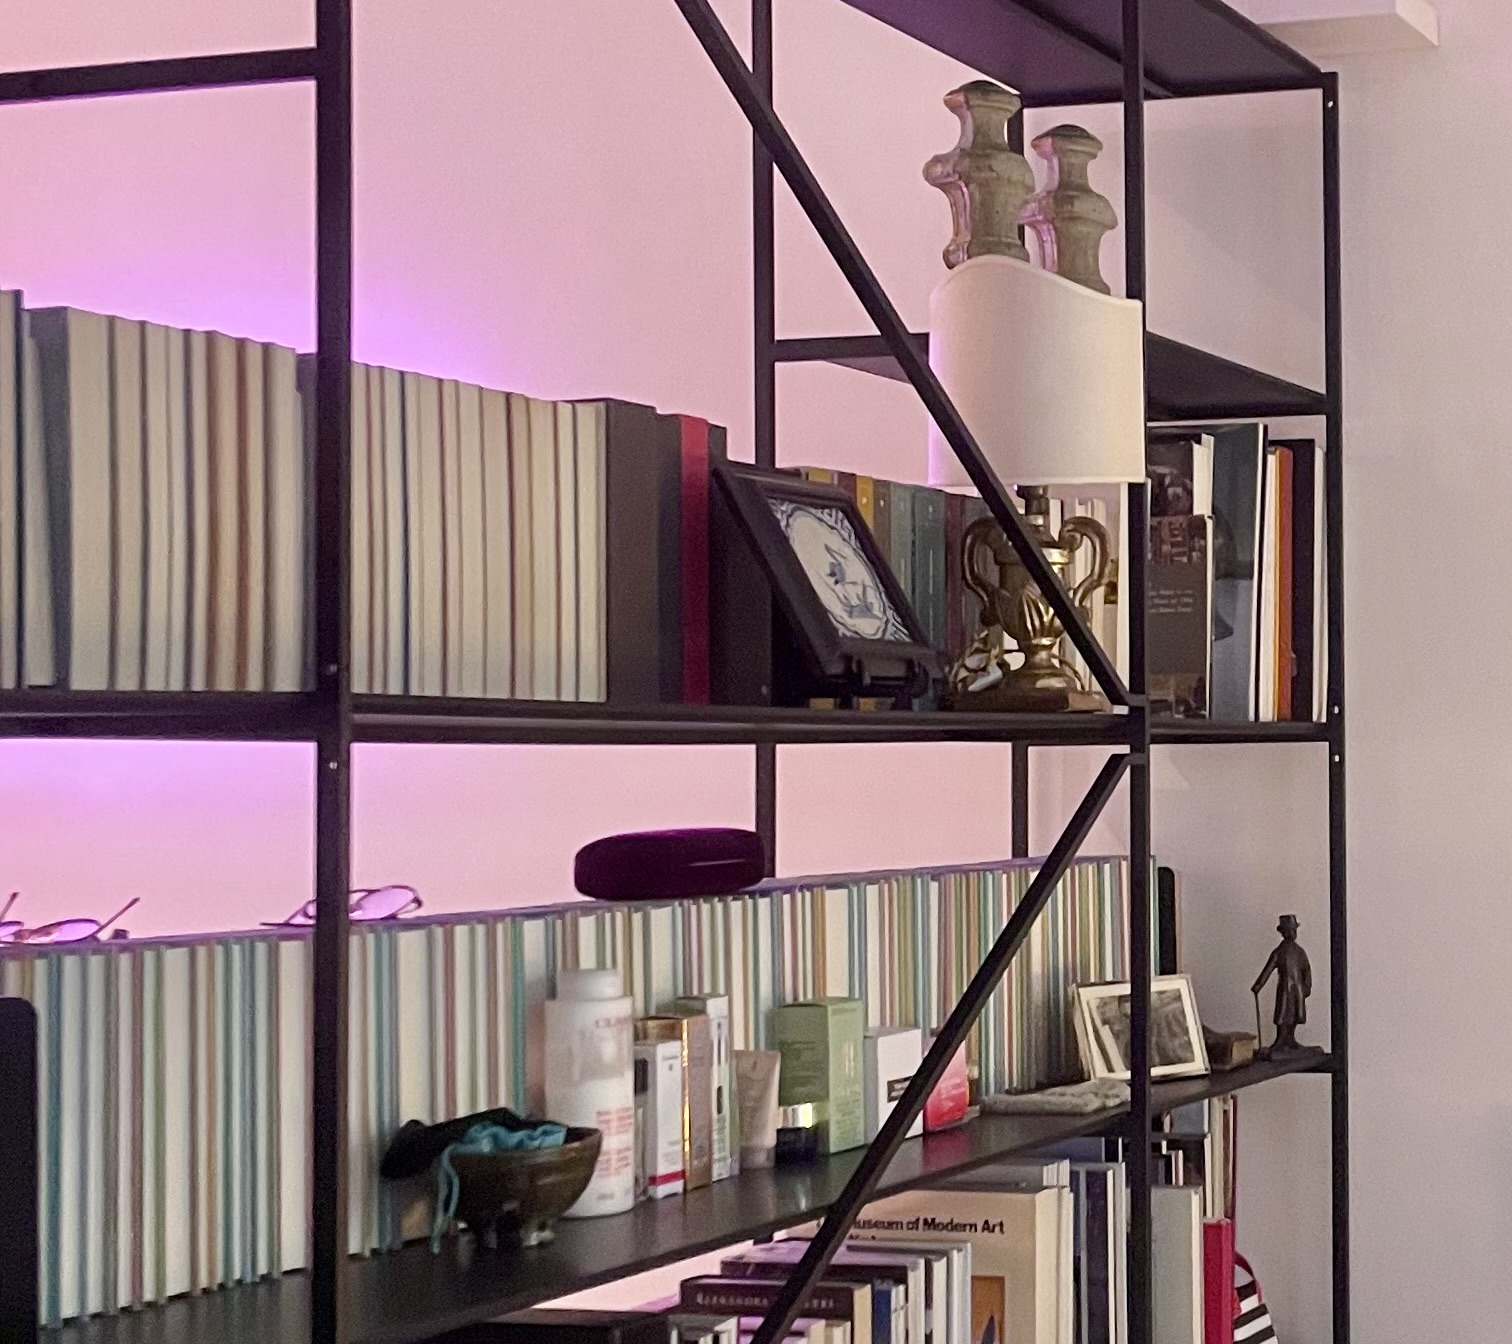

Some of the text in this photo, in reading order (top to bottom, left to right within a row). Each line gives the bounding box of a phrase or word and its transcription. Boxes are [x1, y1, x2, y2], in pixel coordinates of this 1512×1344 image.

[853, 1216, 1005, 1235] useum of Modern Art
